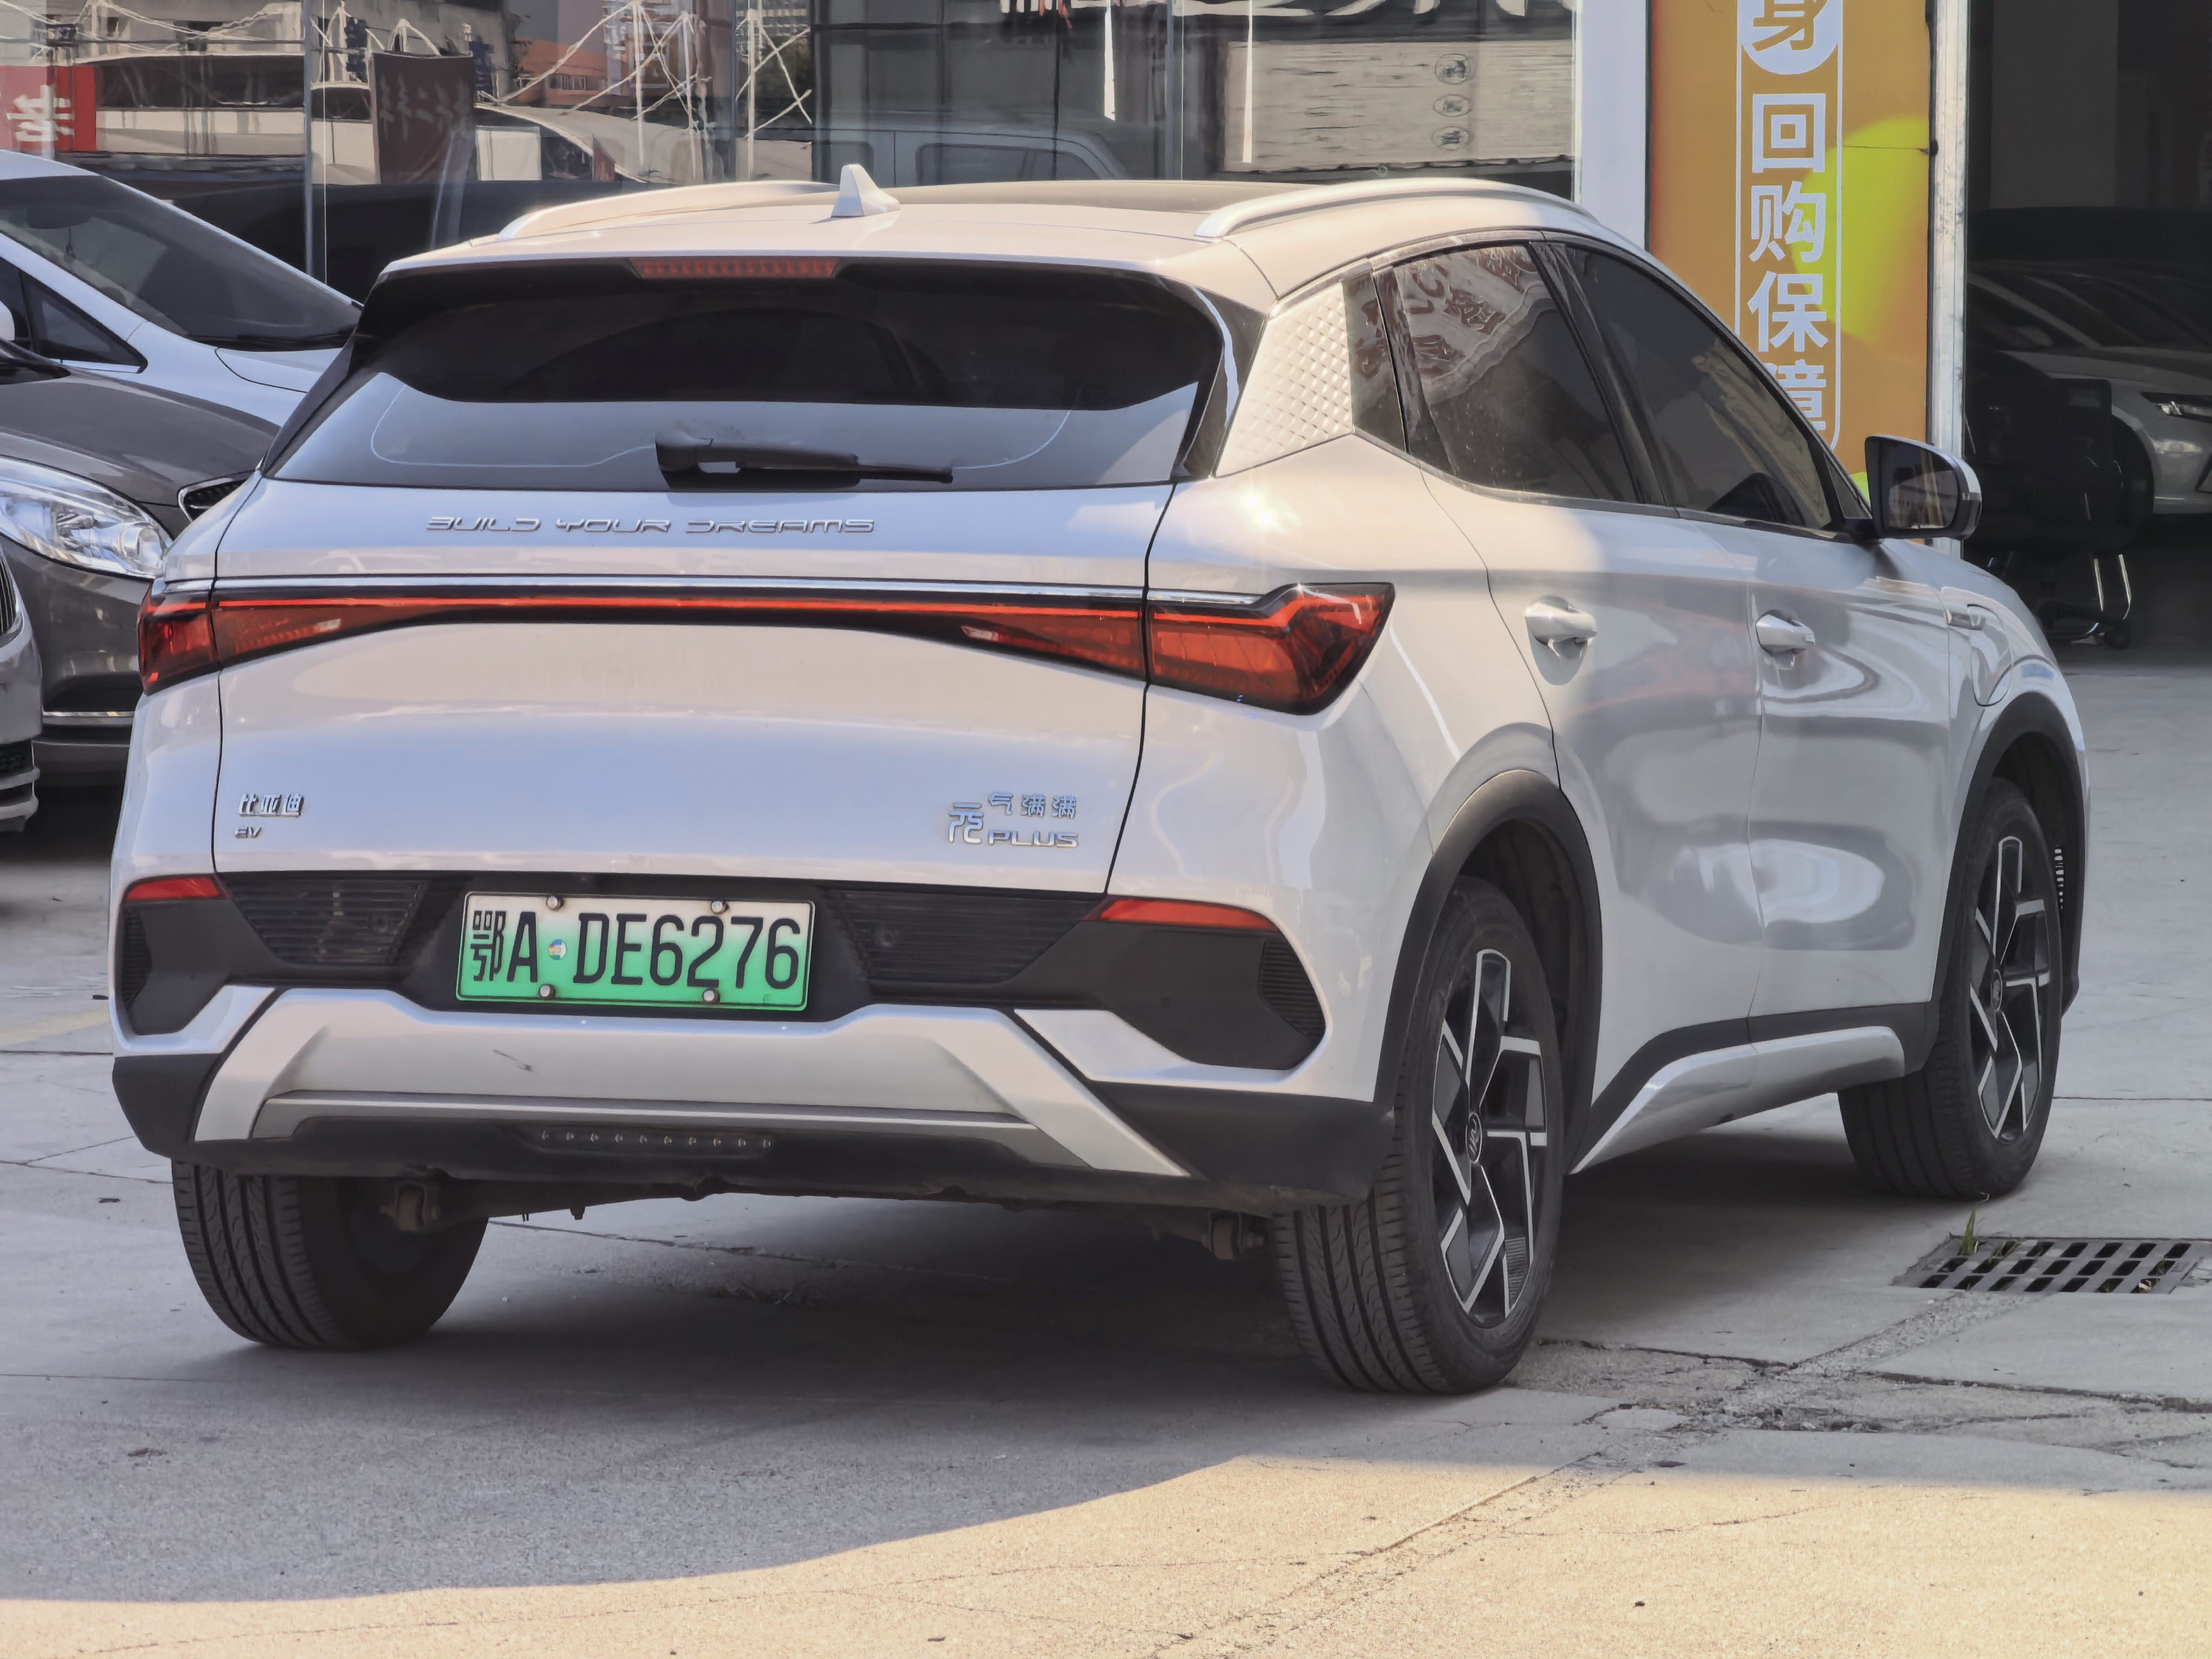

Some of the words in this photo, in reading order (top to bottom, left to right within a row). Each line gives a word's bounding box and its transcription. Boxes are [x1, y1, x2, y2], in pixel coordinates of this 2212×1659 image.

[426, 516, 542, 532] BUILD
[556, 518, 672, 534] YOUR
[685, 519, 875, 534] DREAMS
[239, 794, 305, 818] 比亚迪
[234, 827, 262, 839] EV
[988, 830, 1079, 848] PLUS
